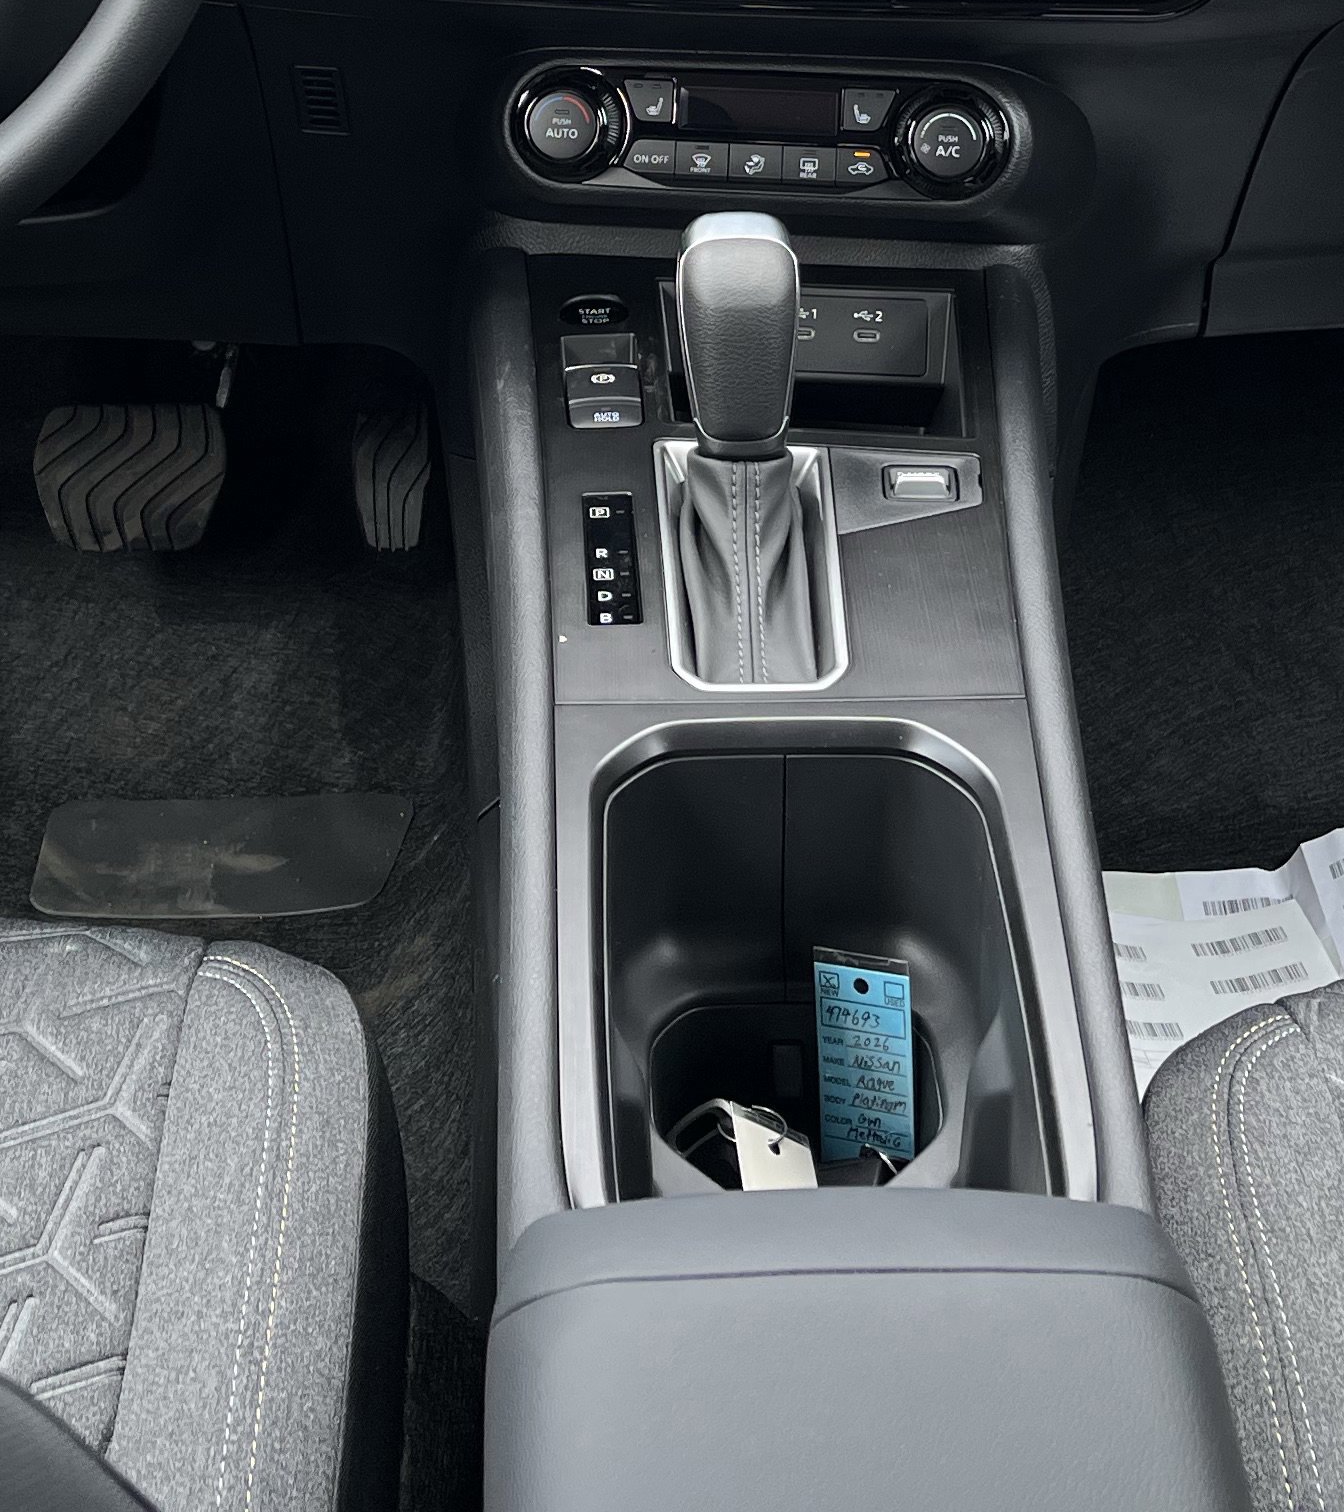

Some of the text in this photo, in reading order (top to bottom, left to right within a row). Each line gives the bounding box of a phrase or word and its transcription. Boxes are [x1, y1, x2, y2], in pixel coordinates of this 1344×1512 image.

[546, 128, 578, 138] AUTO
[935, 145, 960, 158] A/C
[633, 155, 670, 164] ON OFF
[811, 308, 818, 319] 1
[875, 310, 883, 322] 2
[596, 548, 608, 558] R
[598, 591, 612, 601] D
[600, 613, 612, 623] B
[820, 988, 839, 997] NEW
[884, 997, 905, 1007] USED
[823, 1035, 889, 1050] YEAR 2026
[823, 1055, 845, 1066] MAKE
[823, 1075, 851, 1087] MODEL
[824, 1114, 853, 1126] COLOR
